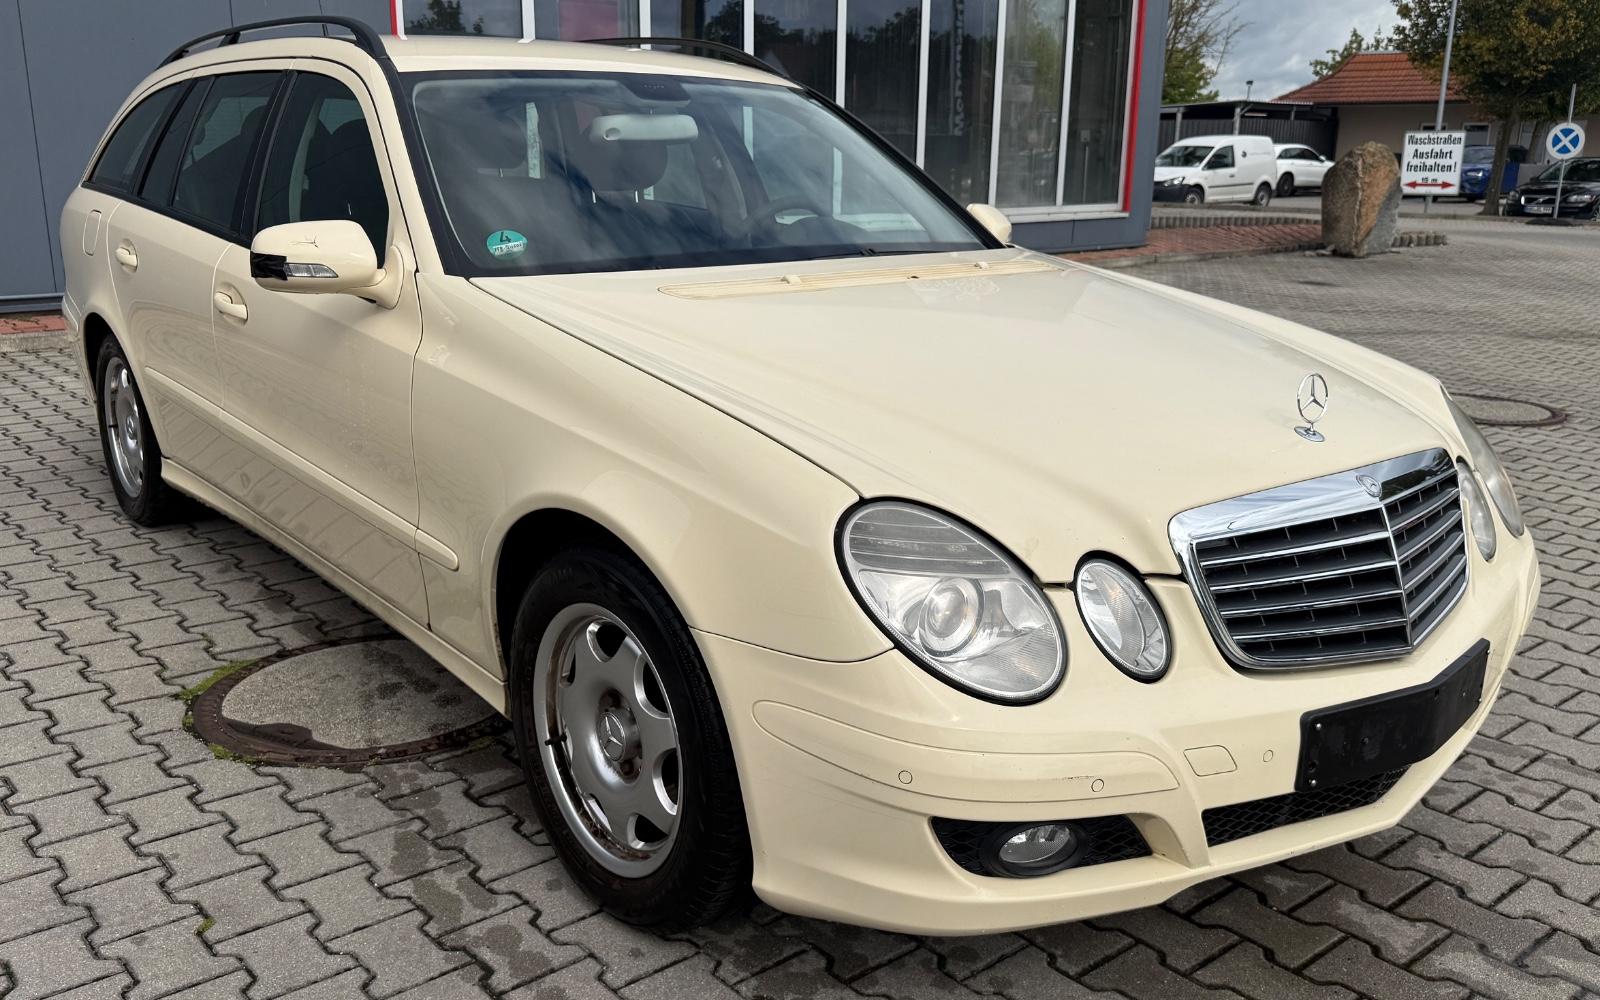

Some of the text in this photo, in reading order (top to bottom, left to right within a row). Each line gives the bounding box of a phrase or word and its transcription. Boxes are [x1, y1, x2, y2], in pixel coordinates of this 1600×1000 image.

[1408, 134, 1462, 145] Waschstraßen
[1412, 148, 1453, 159] Ausfahrt
[1406, 161, 1457, 172] freihalten!
[500, 231, 511, 243] 4
